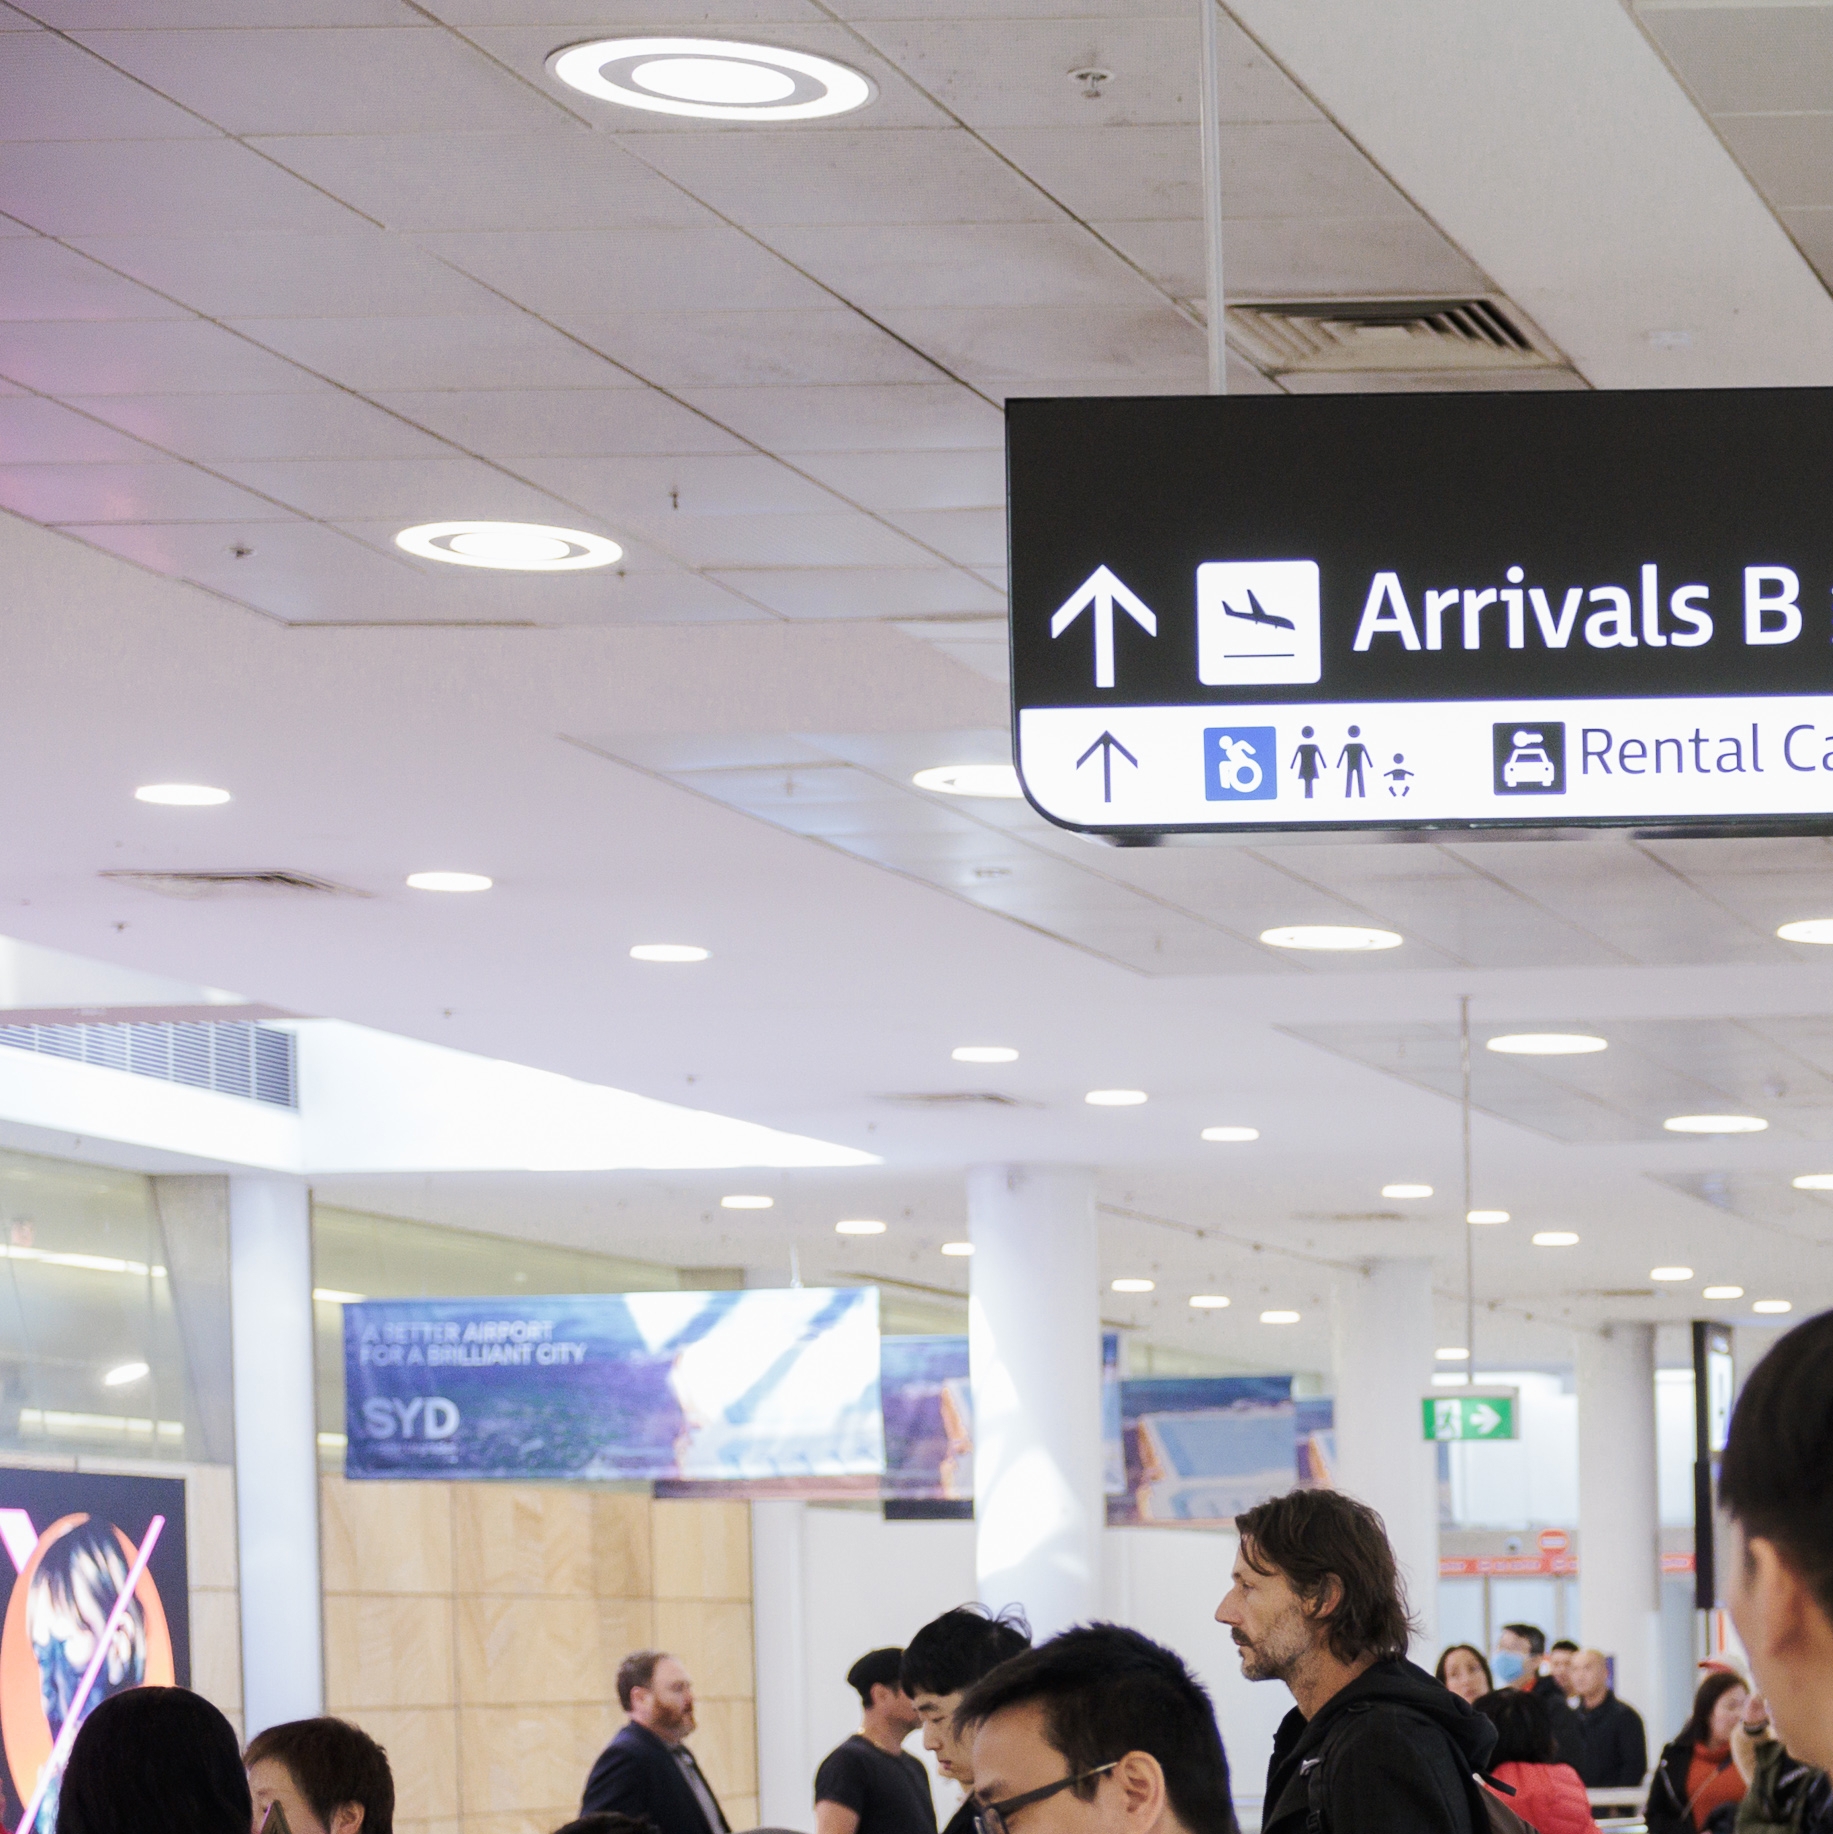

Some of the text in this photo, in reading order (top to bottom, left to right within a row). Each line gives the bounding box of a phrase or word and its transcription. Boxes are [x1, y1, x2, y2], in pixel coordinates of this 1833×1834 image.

[1352, 563, 1714, 652] Arrivals
[1743, 565, 1803, 646] B
[1580, 723, 1765, 777] Rental
[462, 1320, 554, 1344] AIRPORT
[534, 1342, 588, 1366] CITY
[362, 1396, 460, 1441] SYD
